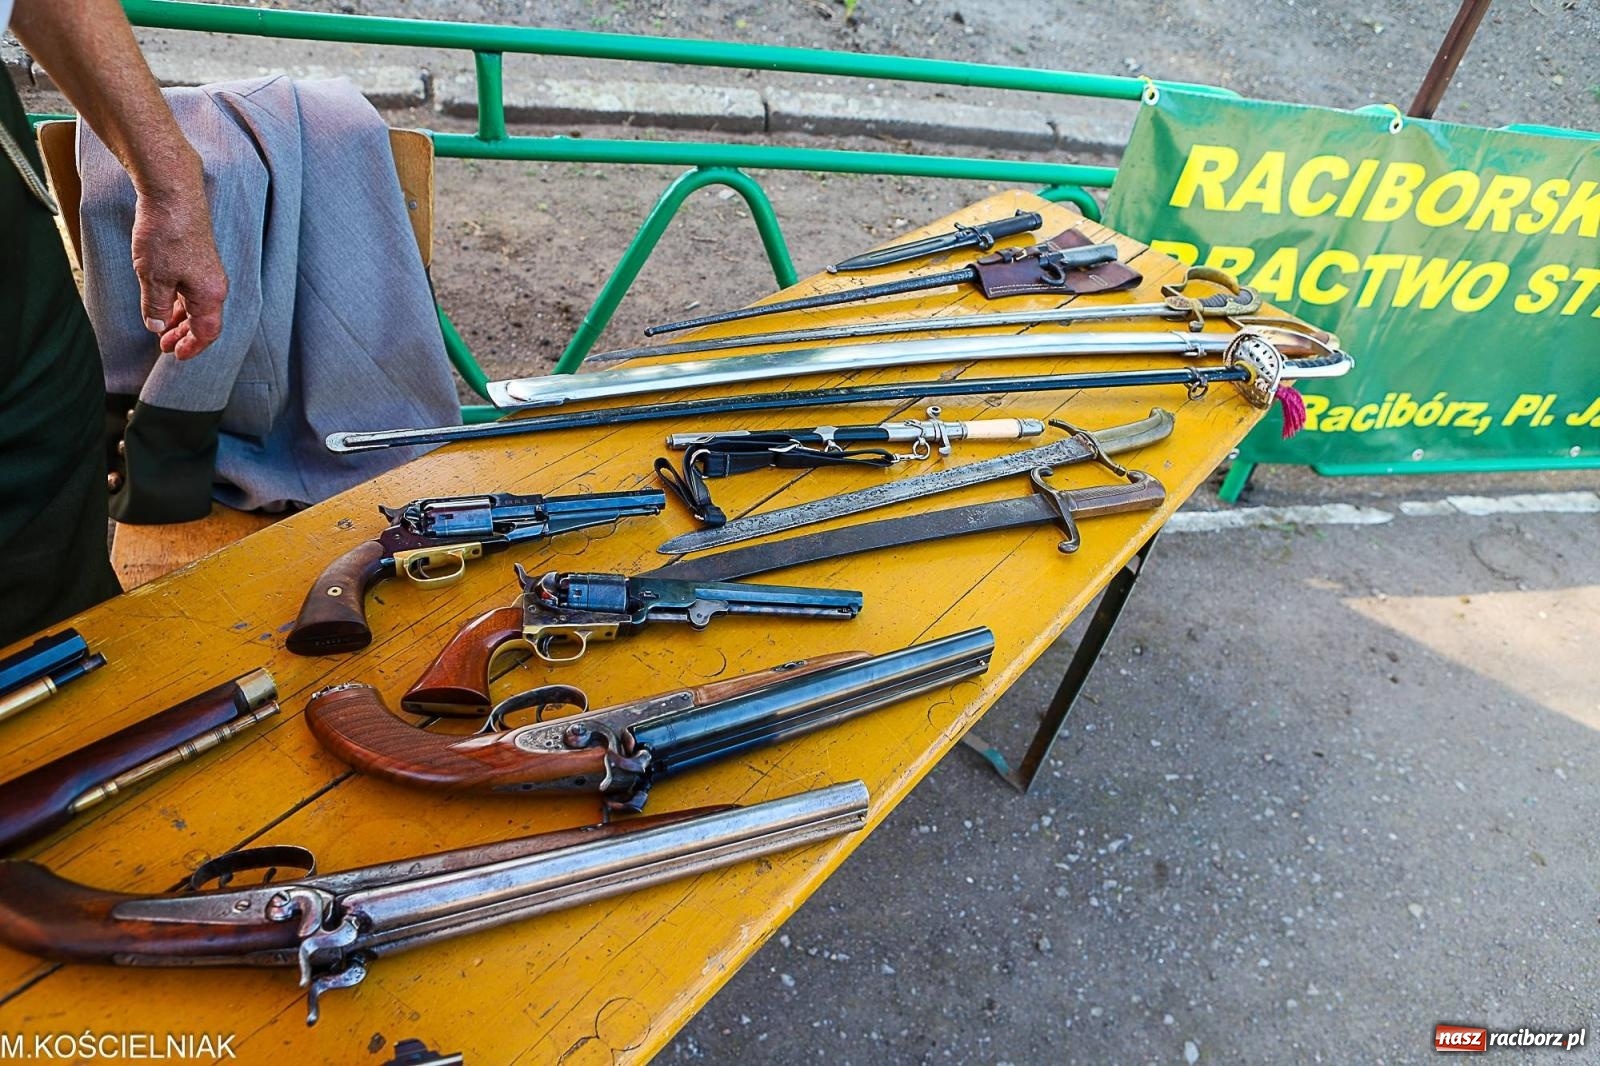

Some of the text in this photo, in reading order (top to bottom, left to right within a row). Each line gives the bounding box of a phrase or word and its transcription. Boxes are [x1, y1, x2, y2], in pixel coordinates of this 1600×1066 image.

[1169, 144, 1600, 238] RACIBORSK
[1514, 264, 1600, 319] ST
[1303, 392, 1600, 435] Racibórz, Pl. J
